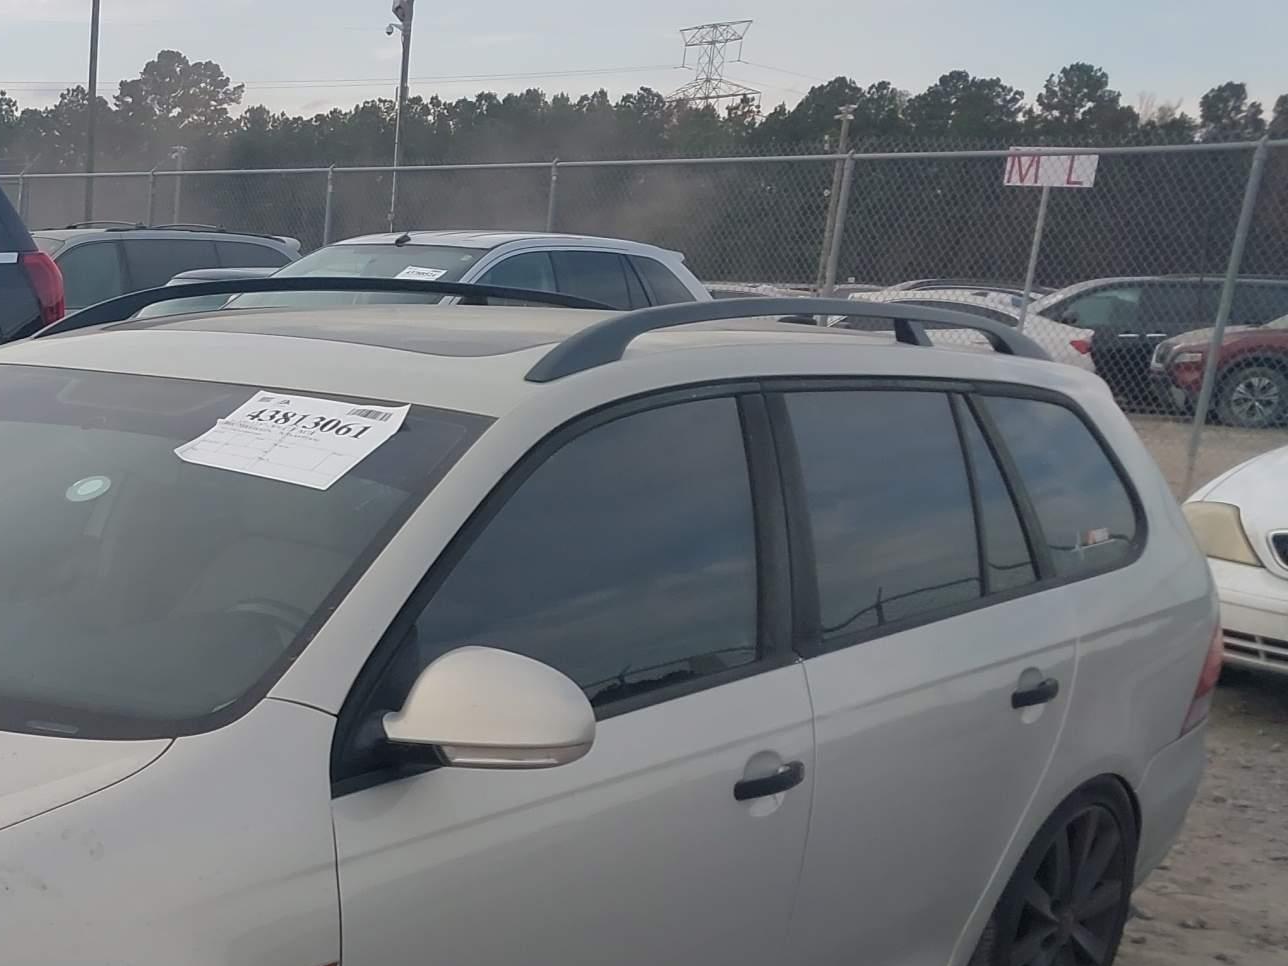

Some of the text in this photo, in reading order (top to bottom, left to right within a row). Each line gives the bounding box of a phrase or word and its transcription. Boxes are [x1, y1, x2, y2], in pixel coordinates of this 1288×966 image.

[1007, 152, 1083, 184] M L
[246, 407, 372, 440] 43813061
